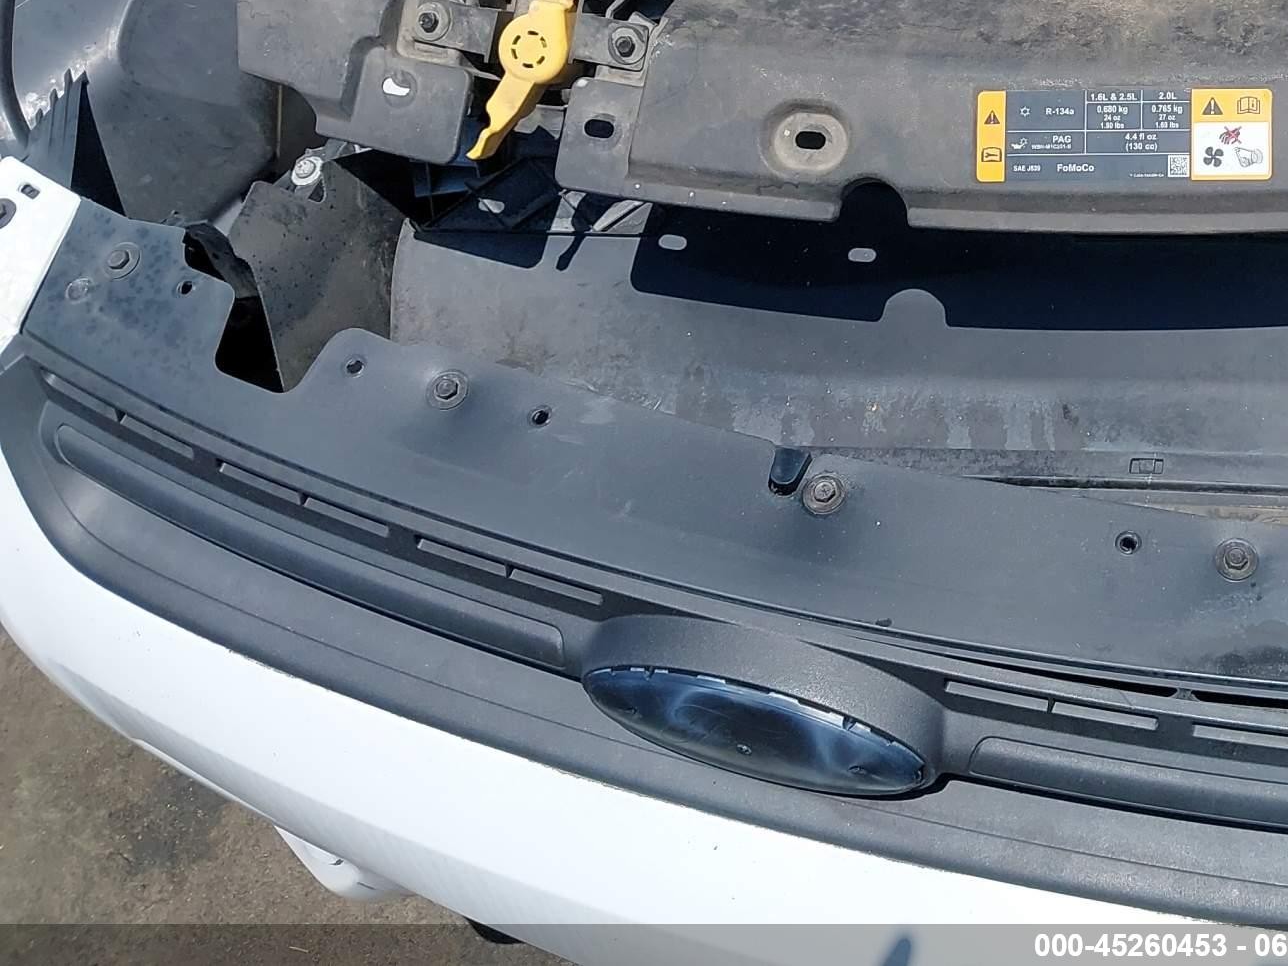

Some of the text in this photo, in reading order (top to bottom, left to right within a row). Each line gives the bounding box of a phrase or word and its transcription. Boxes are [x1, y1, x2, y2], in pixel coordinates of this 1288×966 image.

[1110, 93, 1117, 101] &
[1119, 92, 1138, 101] 2.5L
[1158, 92, 1177, 100] 2.0L
[1045, 107, 1075, 115] R-134a
[1118, 105, 1128, 115] kg
[1151, 104, 1183, 114] 0.765 kg
[1052, 135, 1072, 143] PAG
[1125, 142, 1143, 152] (130
[1057, 164, 1095, 172] FoMoCo
